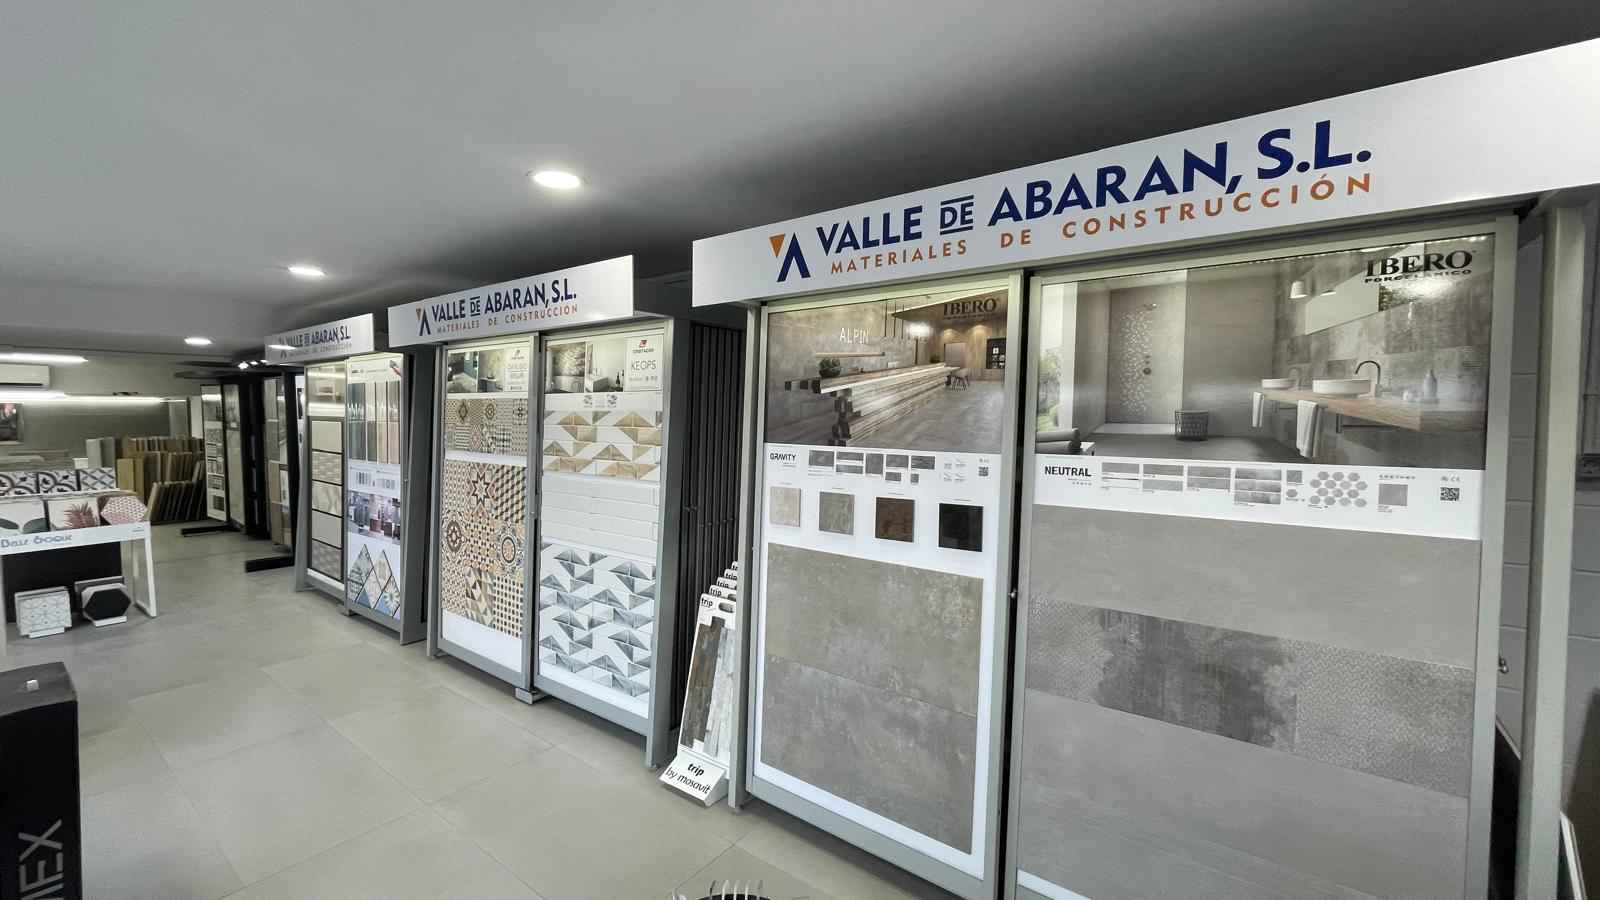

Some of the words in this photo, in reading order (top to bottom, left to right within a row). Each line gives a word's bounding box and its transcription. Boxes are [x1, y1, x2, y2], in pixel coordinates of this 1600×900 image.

[816, 206, 923, 256] VALLE
[940, 202, 974, 230] DE
[988, 141, 1243, 227] ABARAN,
[1257, 119, 1372, 180] S.L.
[831, 239, 967, 275] MATERIALES
[1000, 228, 1031, 249] DE
[1062, 172, 1371, 239] CONSTRUCCIÓN
[1366, 250, 1473, 277] IBERO
[432, 299, 466, 323] VALLE
[470, 299, 480, 314] DE
[484, 282, 549, 314] ABARAN,
[551, 278, 577, 303] S.L.
[943, 298, 997, 316] IBERO
[437, 320, 480, 334] MATERIALES
[488, 317, 498, 327] DE
[505, 301, 578, 323] CONSTRUCCIÓN
[287, 334, 303, 348] VALLE
[839, 327, 869, 344] ALPIN
[631, 360, 656, 371] KEOPS
[769, 453, 796, 461] GRAVITY
[1044, 465, 1092, 478] NEUTRAL
[710, 587, 721, 597] trip
[701, 597, 713, 607] trip
[687, 763, 704, 777] trip
[665, 766, 678, 779] by
[677, 774, 711, 795] mosavit
